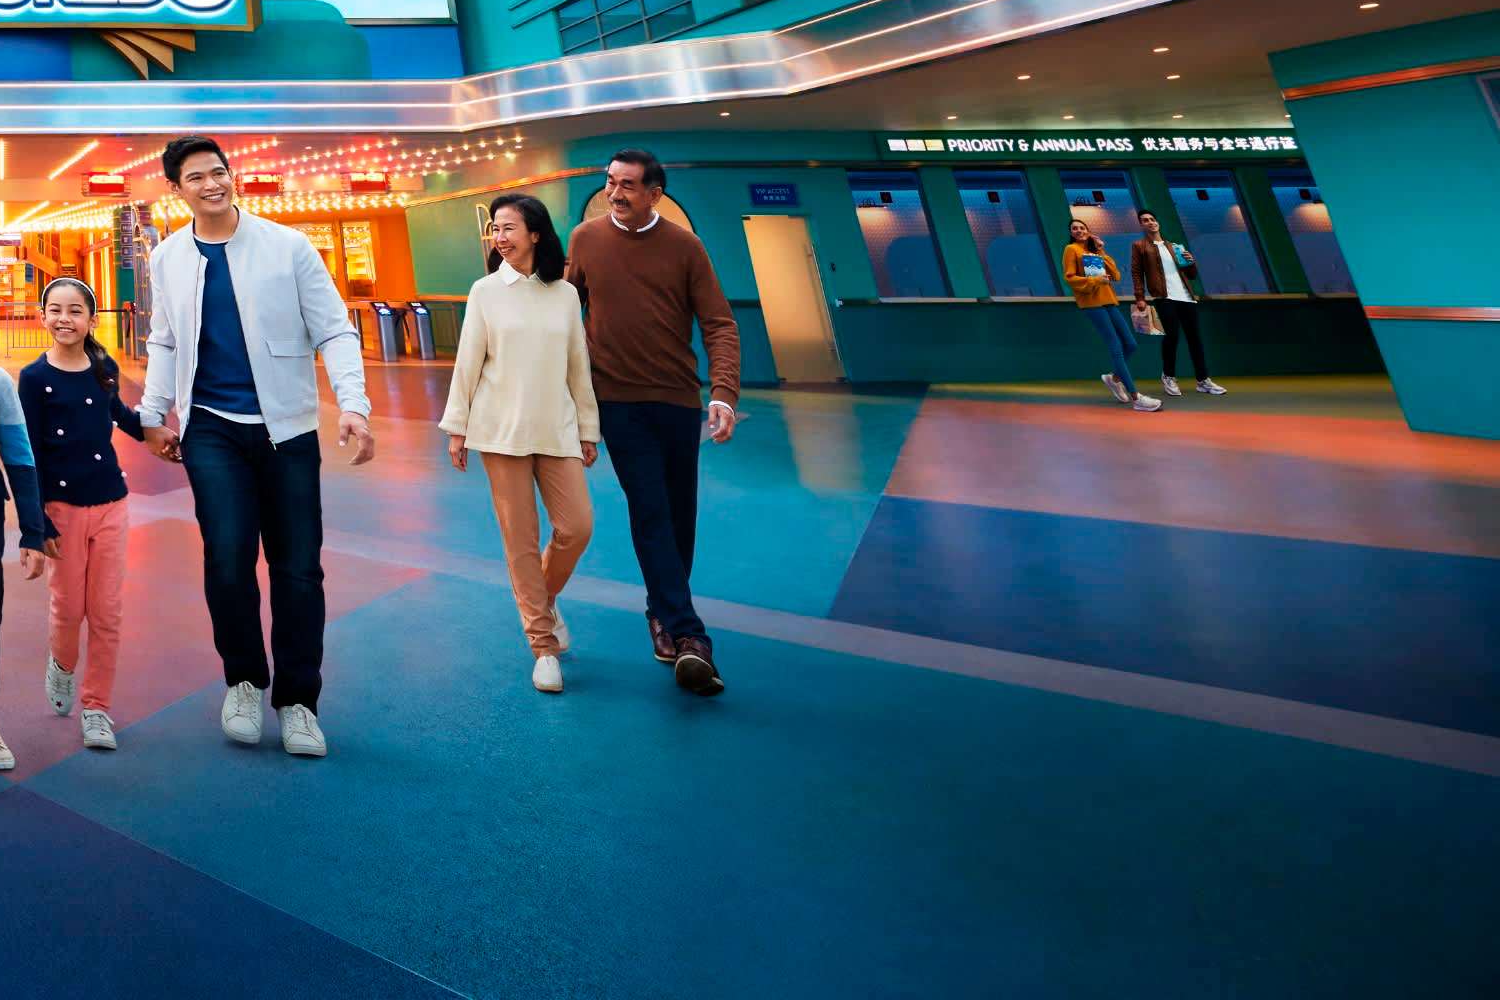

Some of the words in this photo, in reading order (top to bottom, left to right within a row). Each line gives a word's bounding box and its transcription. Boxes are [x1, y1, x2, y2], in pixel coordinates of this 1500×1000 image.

[947, 138, 1014, 152] PRIORITY
[1018, 138, 1029, 152] &
[1033, 138, 1095, 152] ANNUAL
[1096, 138, 1134, 151] PASS
